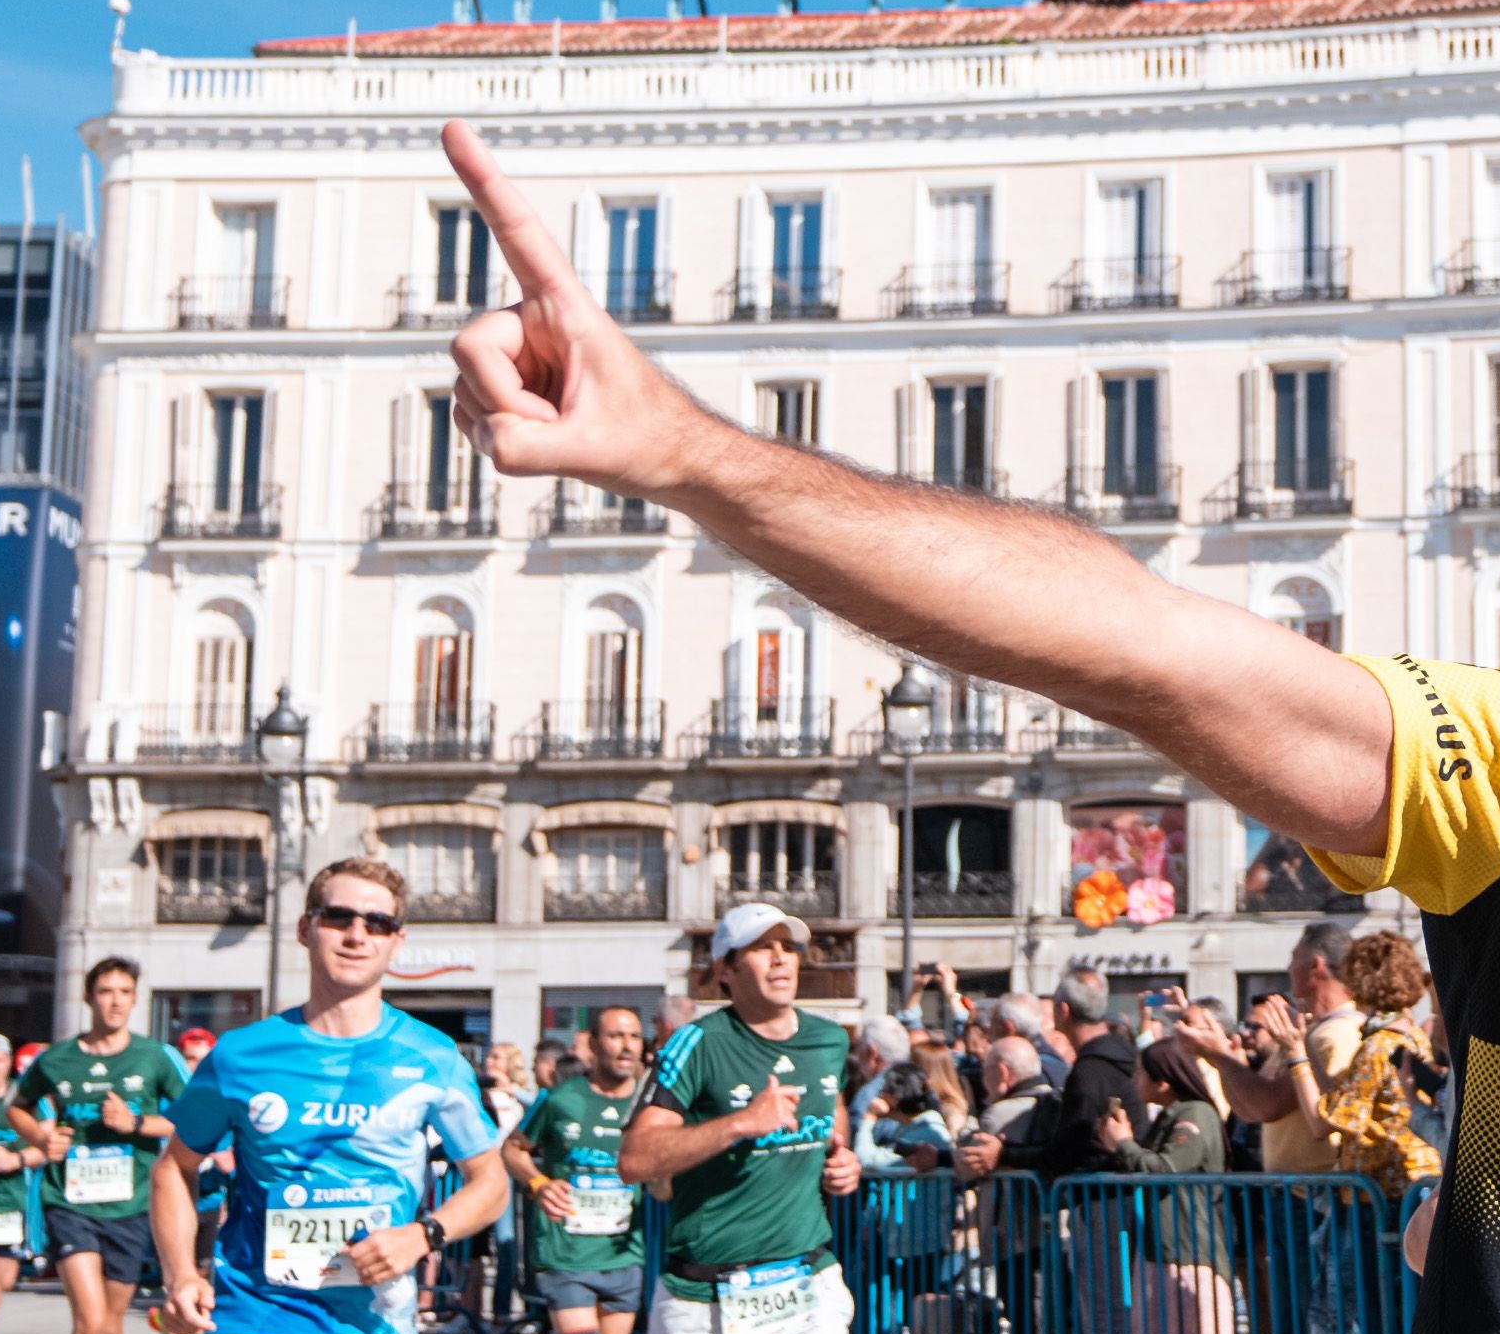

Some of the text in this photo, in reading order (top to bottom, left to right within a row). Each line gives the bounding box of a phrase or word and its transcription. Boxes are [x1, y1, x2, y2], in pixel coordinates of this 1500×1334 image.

[301, 1101, 418, 1129] ZURICH
[312, 1187, 373, 1204] ZURICH
[737, 1290, 798, 1320] 23604
